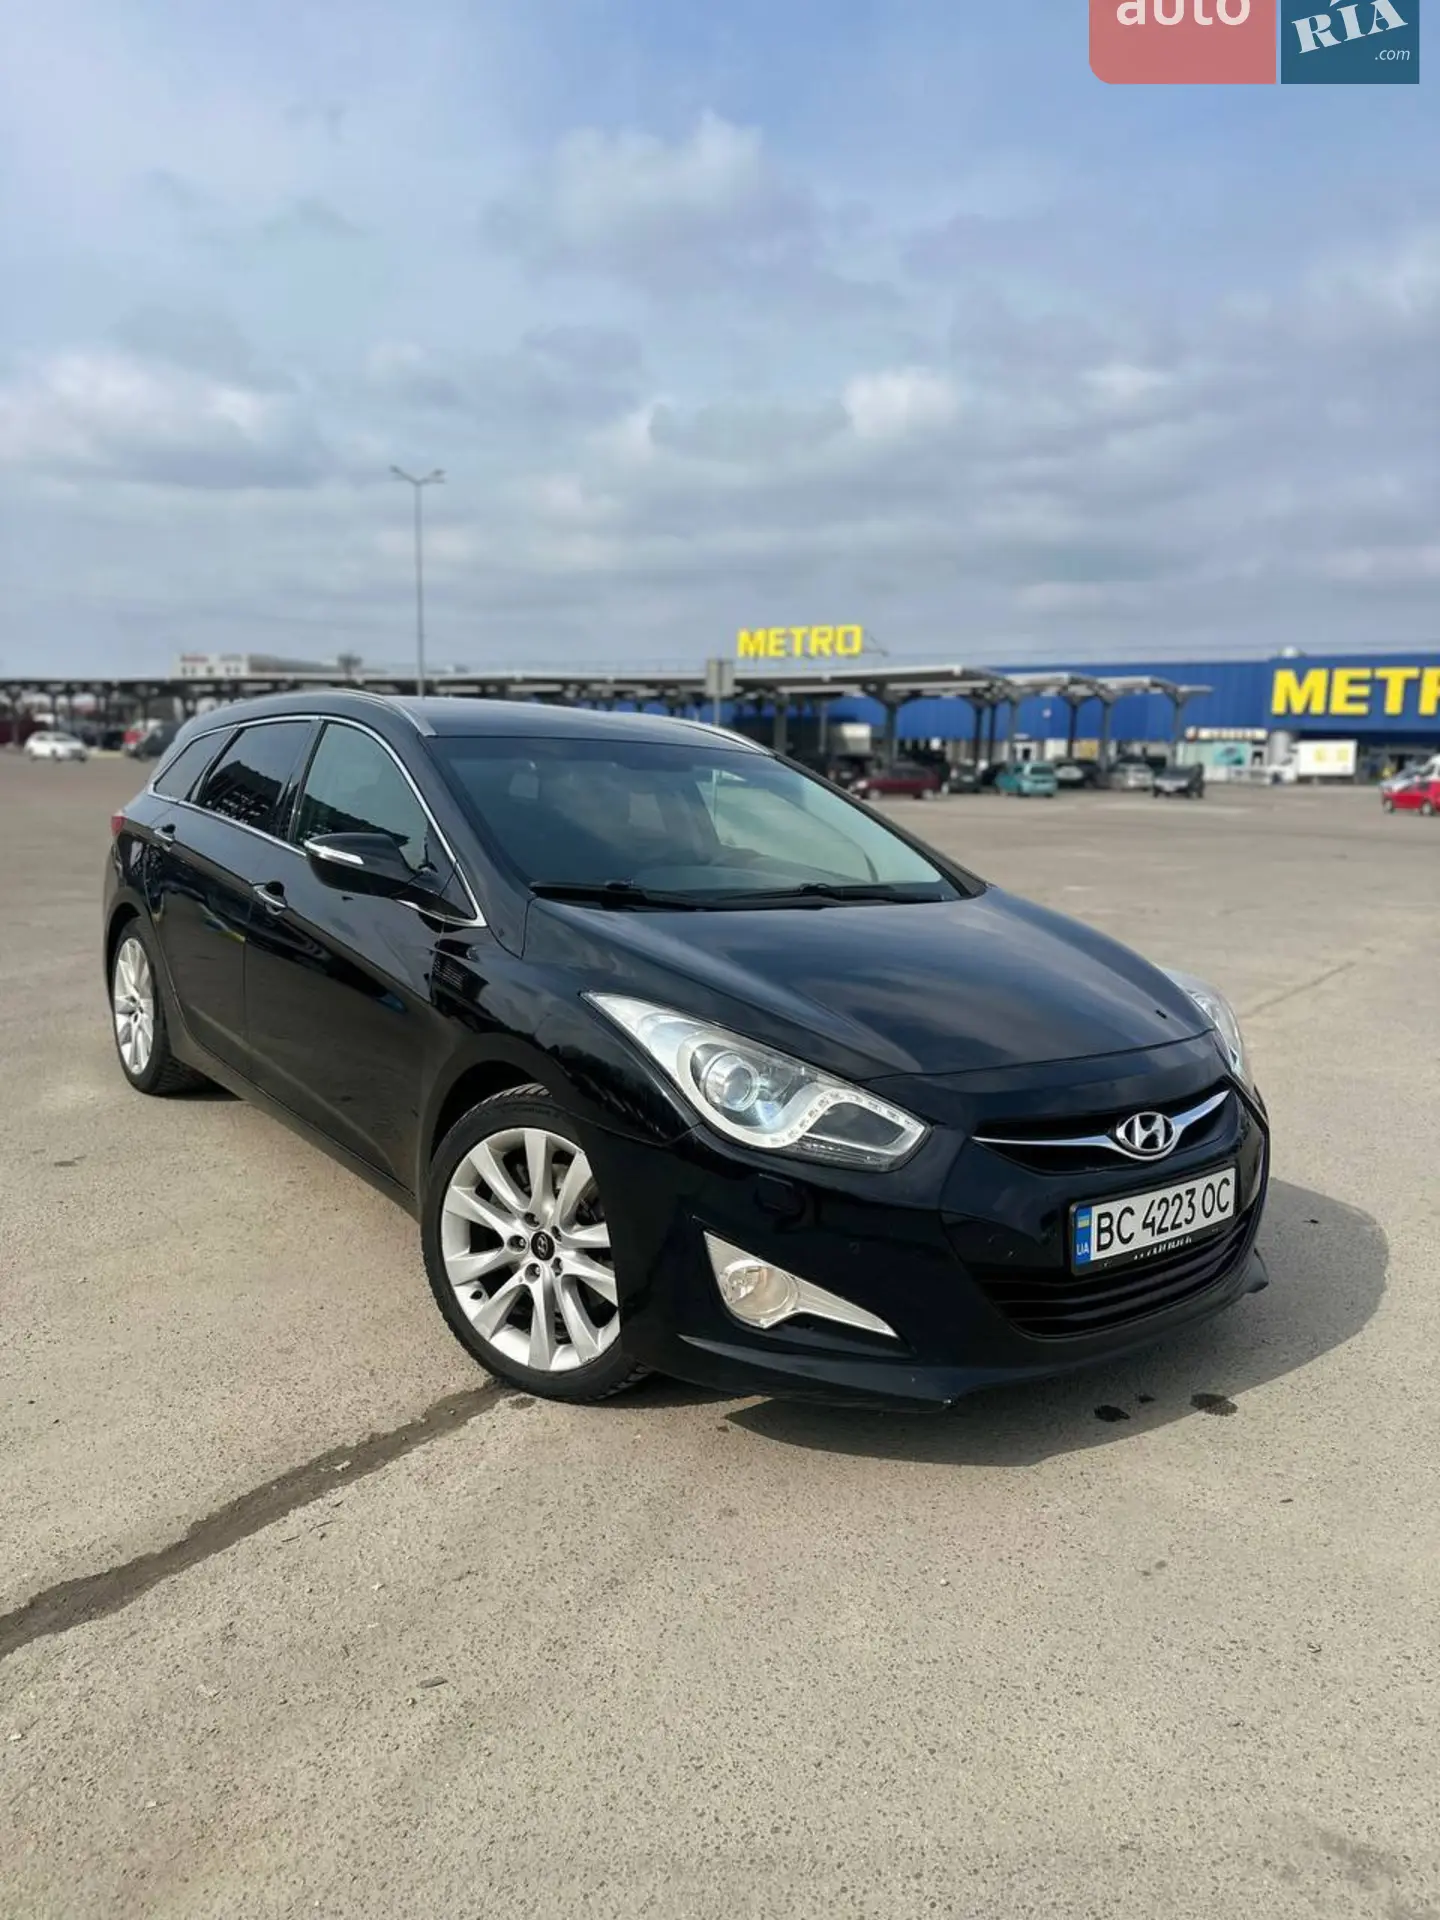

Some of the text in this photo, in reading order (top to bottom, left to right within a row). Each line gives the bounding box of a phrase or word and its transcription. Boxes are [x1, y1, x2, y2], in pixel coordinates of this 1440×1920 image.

[737, 624, 864, 658] METRO
[1096, 1206, 1136, 1252] BC
[1142, 1187, 1197, 1237] 4223
[1201, 1176, 1231, 1219] OC
[1076, 1242, 1090, 1256] UA
